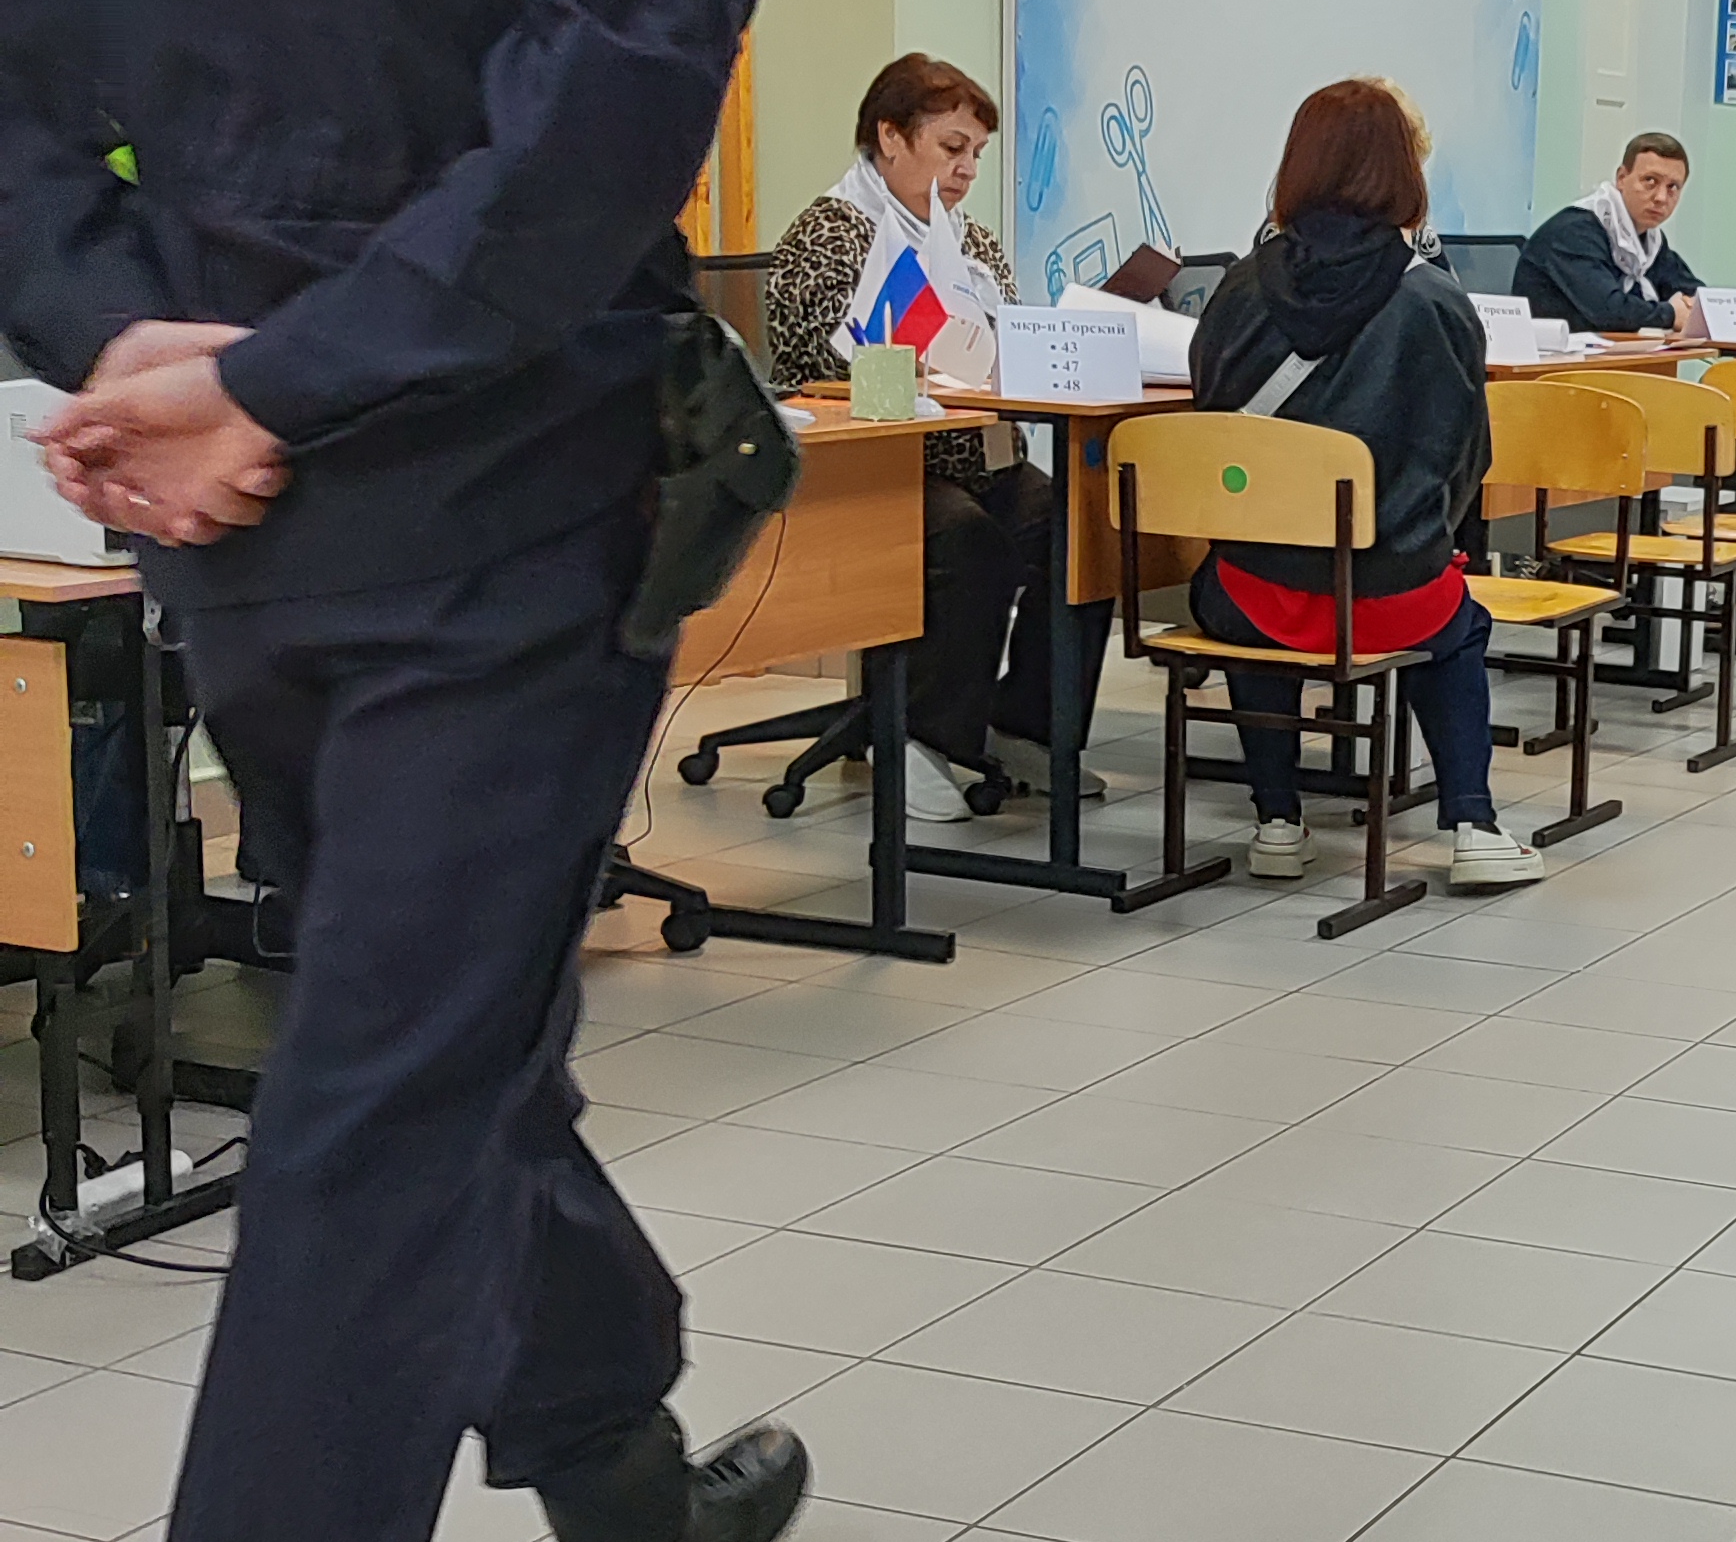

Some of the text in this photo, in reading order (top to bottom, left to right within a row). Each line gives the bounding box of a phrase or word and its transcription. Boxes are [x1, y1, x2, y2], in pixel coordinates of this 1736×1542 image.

[1061, 320, 1126, 336] Горский
[1061, 341, 1078, 353] 43
[1062, 360, 1079, 372] 47
[1063, 379, 1081, 391] 48
